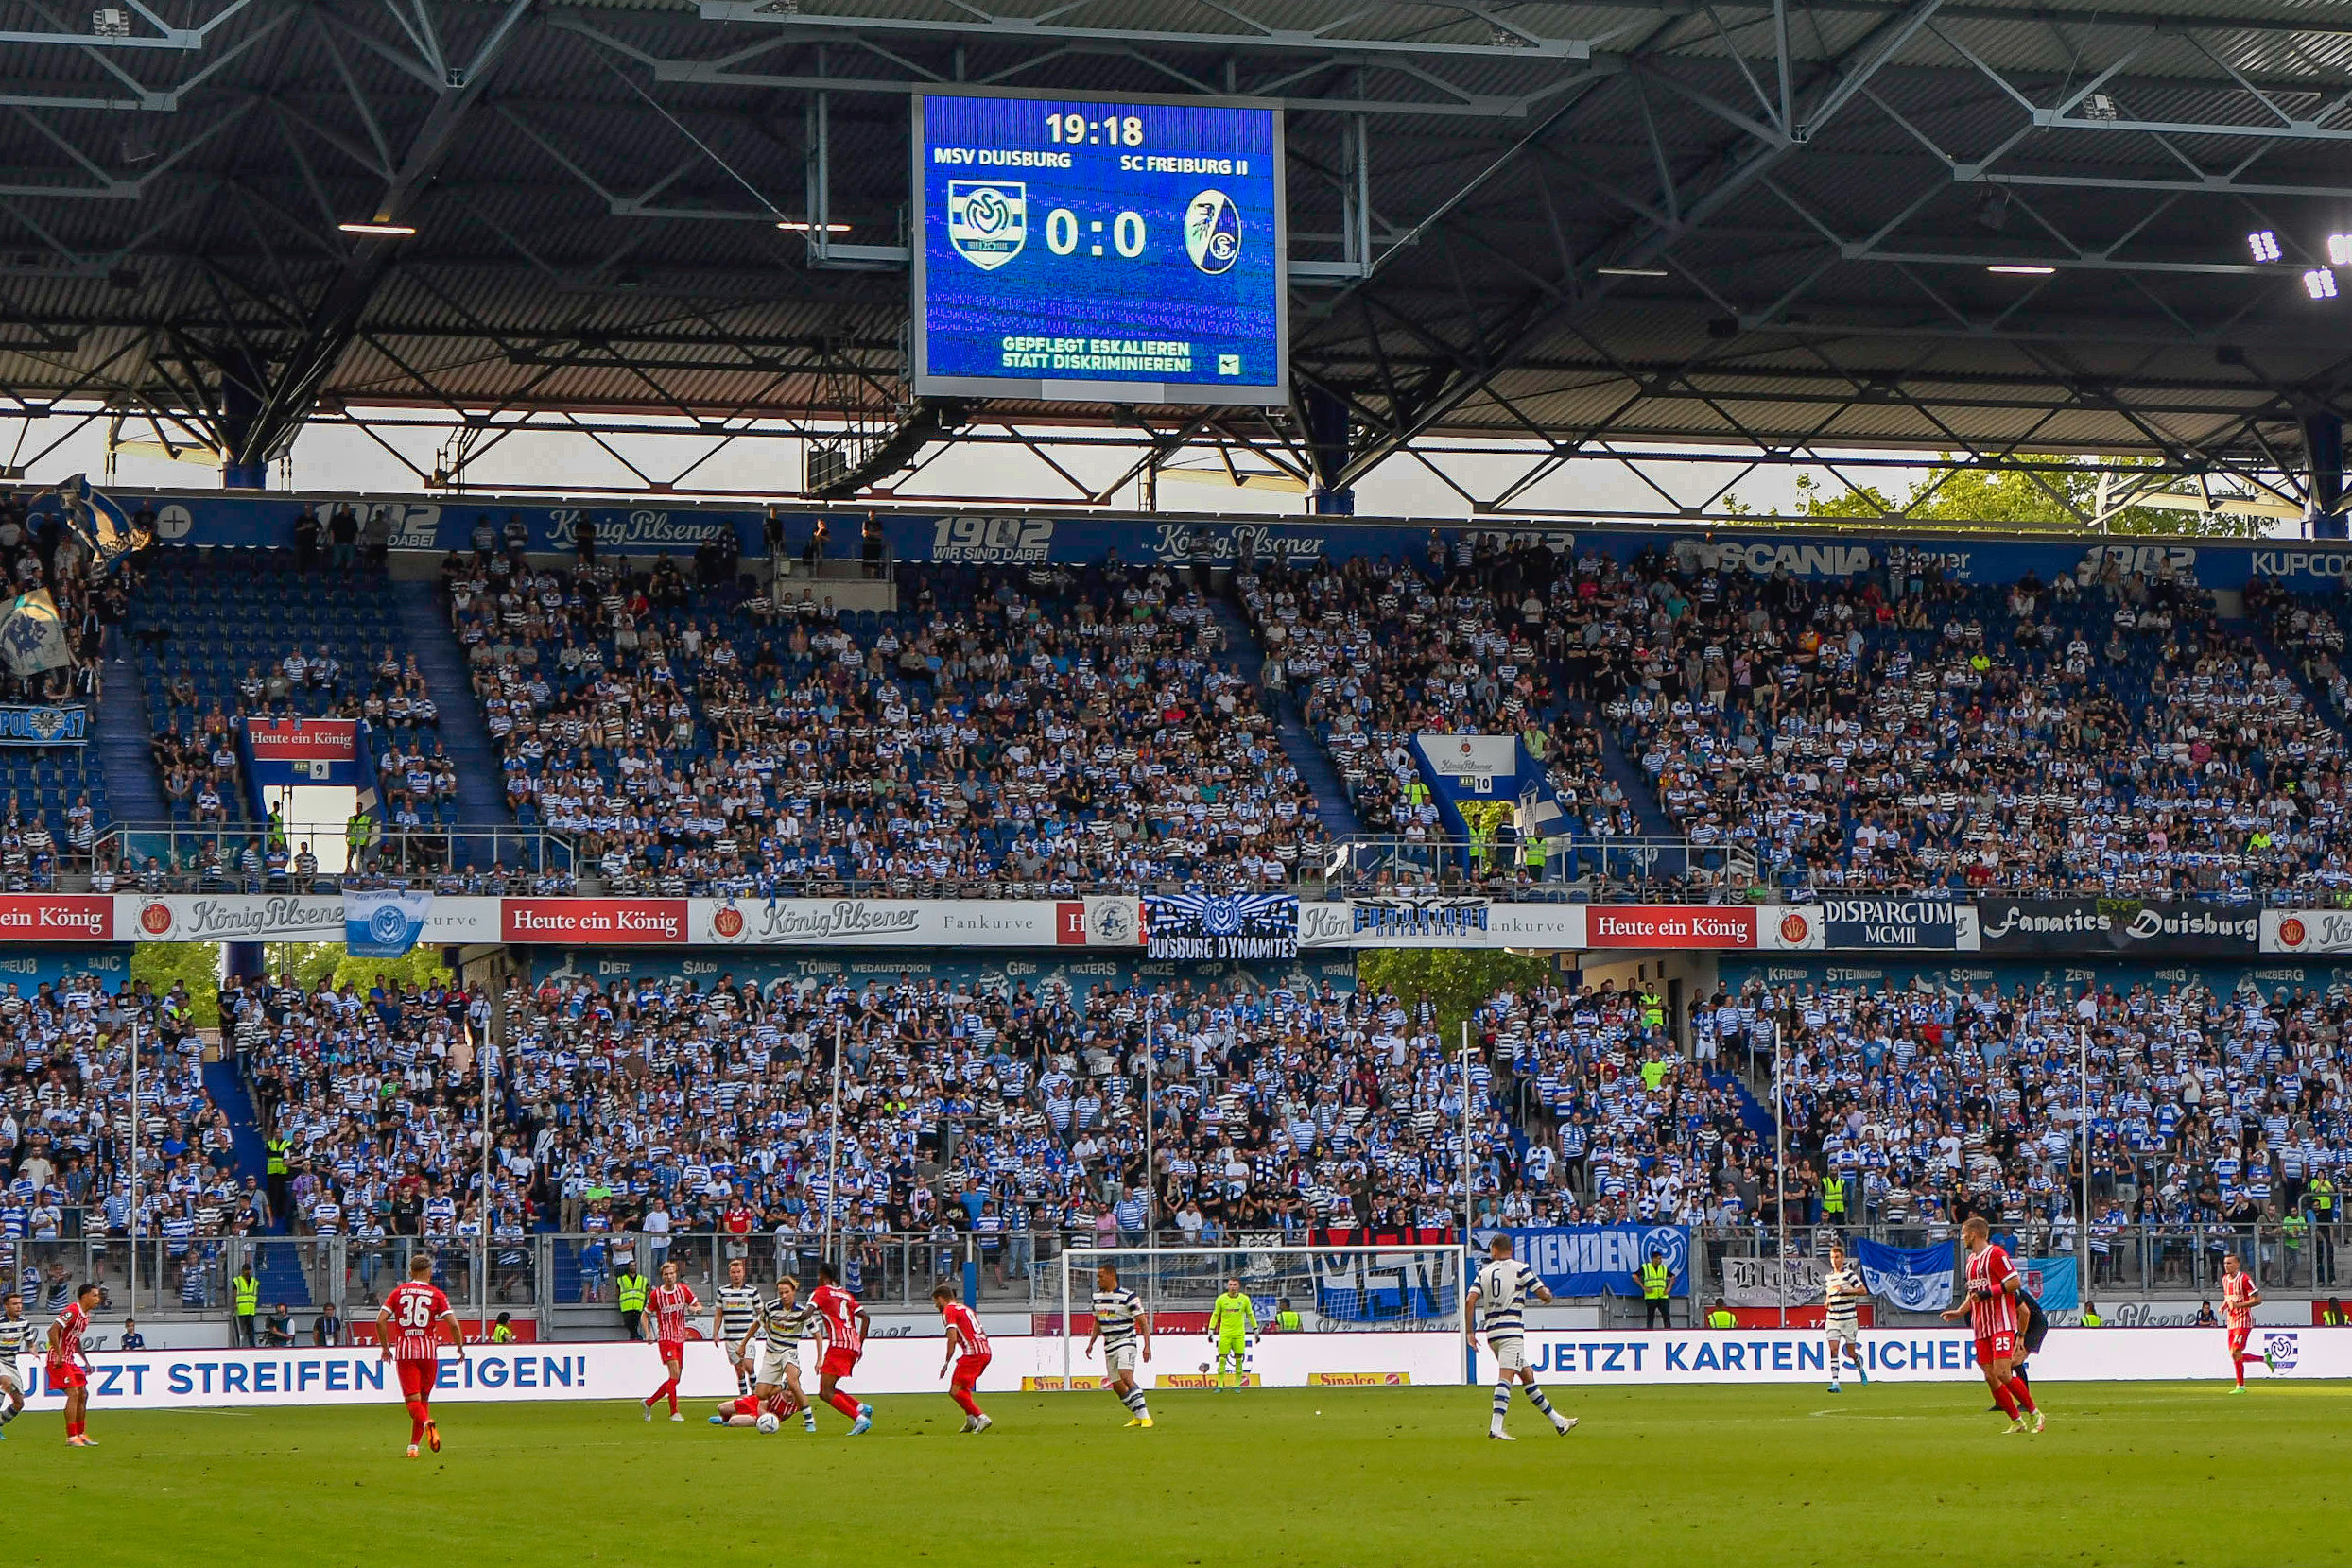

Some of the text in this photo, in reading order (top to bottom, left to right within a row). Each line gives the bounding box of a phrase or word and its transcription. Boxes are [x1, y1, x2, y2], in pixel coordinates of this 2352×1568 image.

[1046, 113, 1144, 146] 19:18
[934, 147, 1072, 168] MSV DUISBURG
[1120, 155, 1249, 176] SC FREIBURG II
[1046, 207, 1146, 258] 0:0
[1002, 336, 1191, 356] GEPFLEGT ESKALIEREN
[1002, 353, 1192, 372] STATT DISKRIMINIEREN!
[545, 509, 727, 545] Knig Pilsener
[933, 517, 1054, 550] 1902
[387, 534, 436, 547] DABEI
[932, 545, 1049, 561] WIR SIND DABEI
[1152, 524, 1324, 558] Köig Plsener
[1717, 542, 1870, 575] SCANIA
[62, 709, 86, 738] 47
[251, 731, 352, 750] Heute ein König
[316, 763, 323, 776] 9
[1477, 777, 1490, 790] 10
[0, 906, 103, 935] ein König
[188, 897, 265, 935] König
[263, 897, 344, 926] Pilsene
[513, 909, 679, 939] Heute ein König
[758, 902, 832, 937] König
[830, 900, 919, 931] Pilsener
[943, 914, 1035, 930] Fankurve
[1302, 906, 1350, 939] Kön
[1491, 916, 1565, 932] ankurve
[1825, 900, 1954, 925] DISPARGUM
[1983, 905, 2112, 939] Fanatics
[2125, 907, 2259, 942] Duisburg
[1597, 916, 1748, 944] Heute ein König
[1864, 924, 1917, 945] MCMII
[1148, 936, 1299, 960] DUISBURG DYNAMITES
[851, 963, 931, 974] WEDAUSTADION
[1825, 966, 1883, 982] STEININGER
[1950, 967, 1994, 981] SCHMIDT
[1491, 1268, 1501, 1298] 6
[399, 1294, 432, 1327] 36
[2116, 1303, 2198, 1327] Pilsene
[1531, 1340, 2030, 1373] JETZT KARTEN SICHER
[1995, 1337, 2011, 1352] 25
[23, 1355, 586, 1399] JZT STREIFEN EIGEN!
[1319, 1372, 1376, 1386] Sinalco
